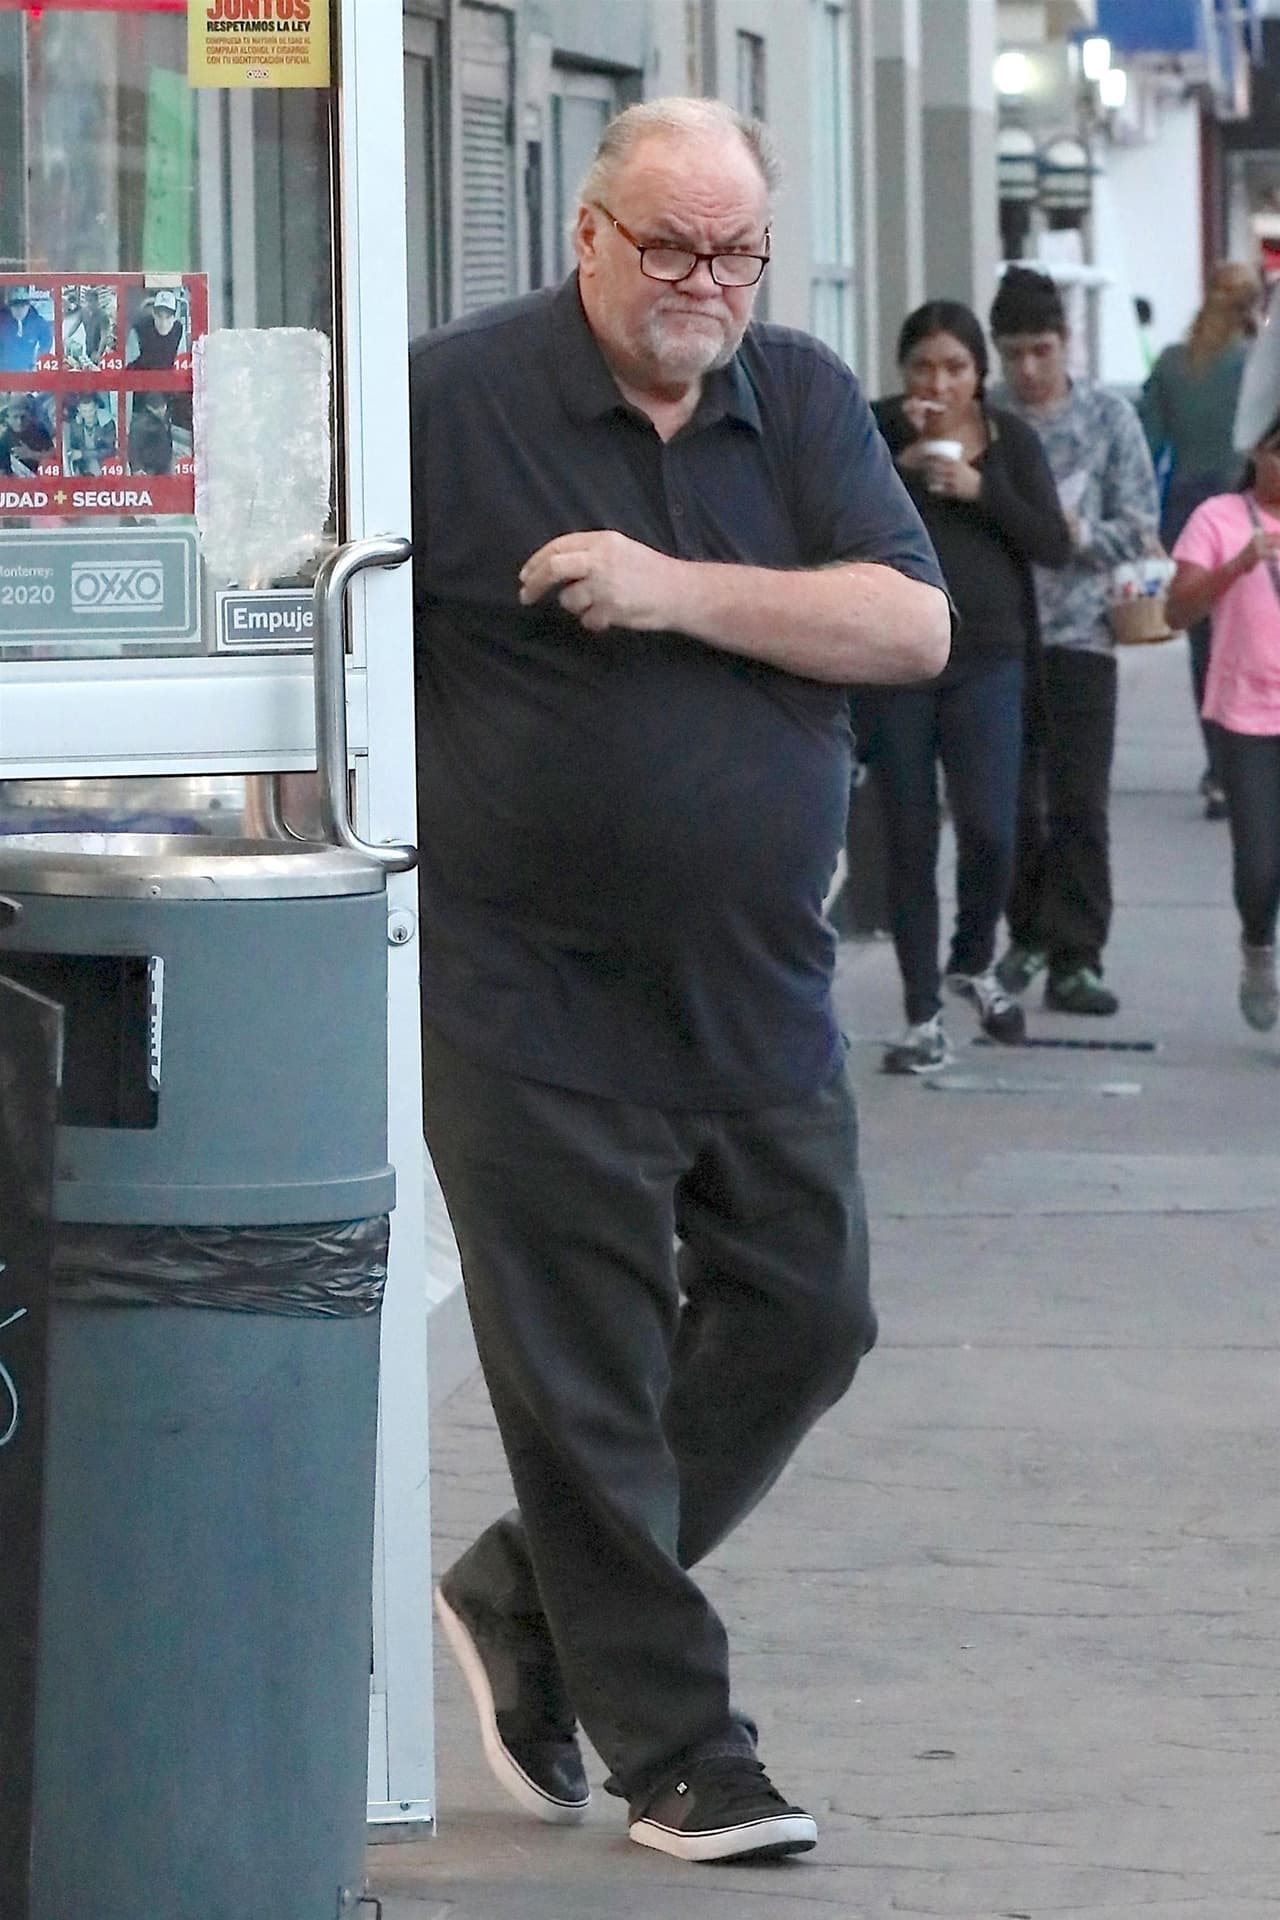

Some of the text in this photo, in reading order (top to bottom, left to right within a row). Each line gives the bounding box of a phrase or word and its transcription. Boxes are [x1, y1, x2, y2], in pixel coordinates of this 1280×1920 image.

[207, 0, 311, 20] JUNTOS
[207, 21, 311, 32] RESPETAMOS LA LEY
[36, 360, 59, 371] 142
[100, 359, 123, 370] 143
[174, 359, 193, 370] 14
[37, 465, 60, 476] 148
[101, 465, 123, 476] 149
[73, 491, 153, 507] SEGURA
[74, 569, 161, 604] OXXO
[2, 585, 55, 605] 2020
[233, 606, 313, 633] Empuje
